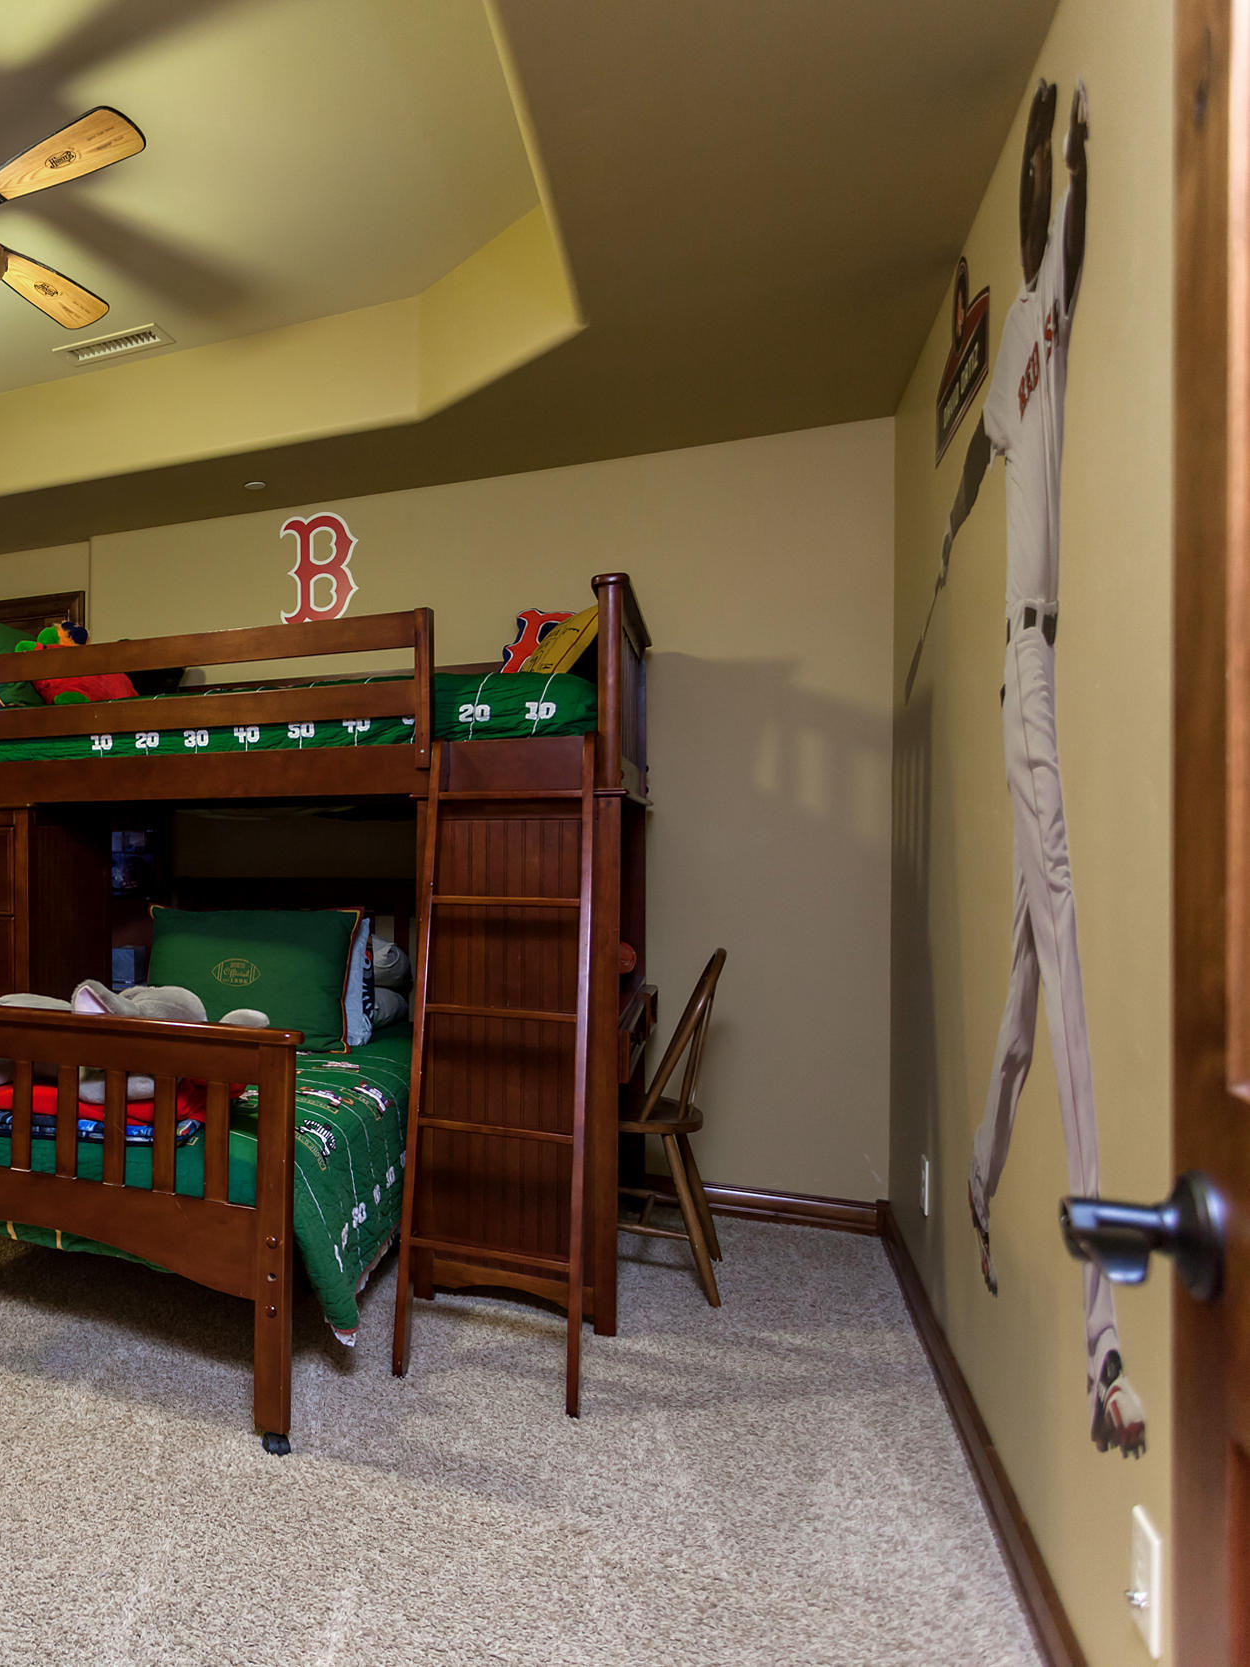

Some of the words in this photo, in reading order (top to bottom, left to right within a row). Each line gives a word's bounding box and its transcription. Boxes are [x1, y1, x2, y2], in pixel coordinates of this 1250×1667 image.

[280, 512, 360, 624] B
[90, 734, 113, 751] 10
[135, 731, 160, 749] 20
[183, 729, 209, 748] 30
[233, 725, 260, 744] 40
[287, 722, 316, 739] 50
[458, 703, 491, 722] 20
[525, 701, 556, 721] 10
